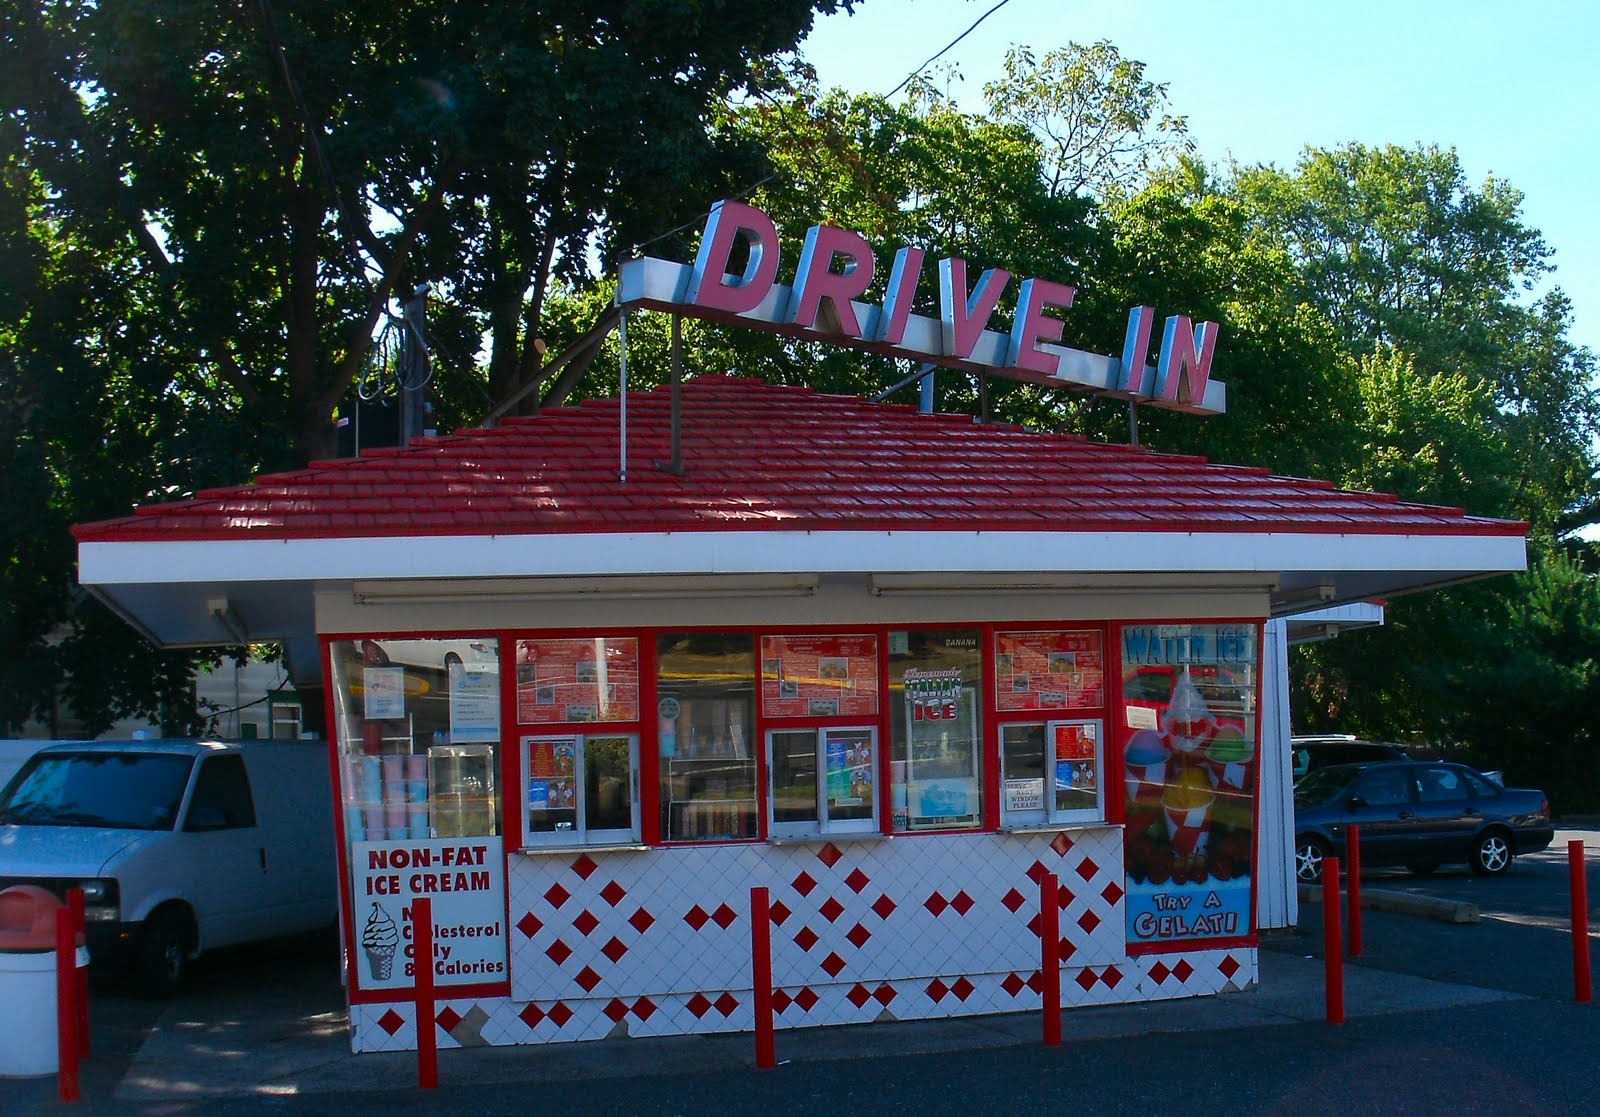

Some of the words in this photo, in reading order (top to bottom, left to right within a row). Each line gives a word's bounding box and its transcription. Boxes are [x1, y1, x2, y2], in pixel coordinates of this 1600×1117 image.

[691, 199, 1076, 375] DRIVE
[1118, 305, 1220, 405] IN
[945, 638, 976, 647] BANANA
[1124, 627, 1204, 664] WATER
[1215, 627, 1249, 664] ICE
[904, 677, 962, 699] ITALIAN
[914, 699, 957, 720] ICE
[368, 845, 487, 870] NON-FAT
[366, 874, 401, 896] ICE
[409, 871, 490, 893] CREAM
[1152, 892, 1193, 911] TRY
[1203, 890, 1222, 909] A
[402, 921, 500, 940] Clesterol
[1134, 911, 1238, 939] GELATI
[403, 942, 452, 960] Oly
[435, 959, 504, 976] Calories
